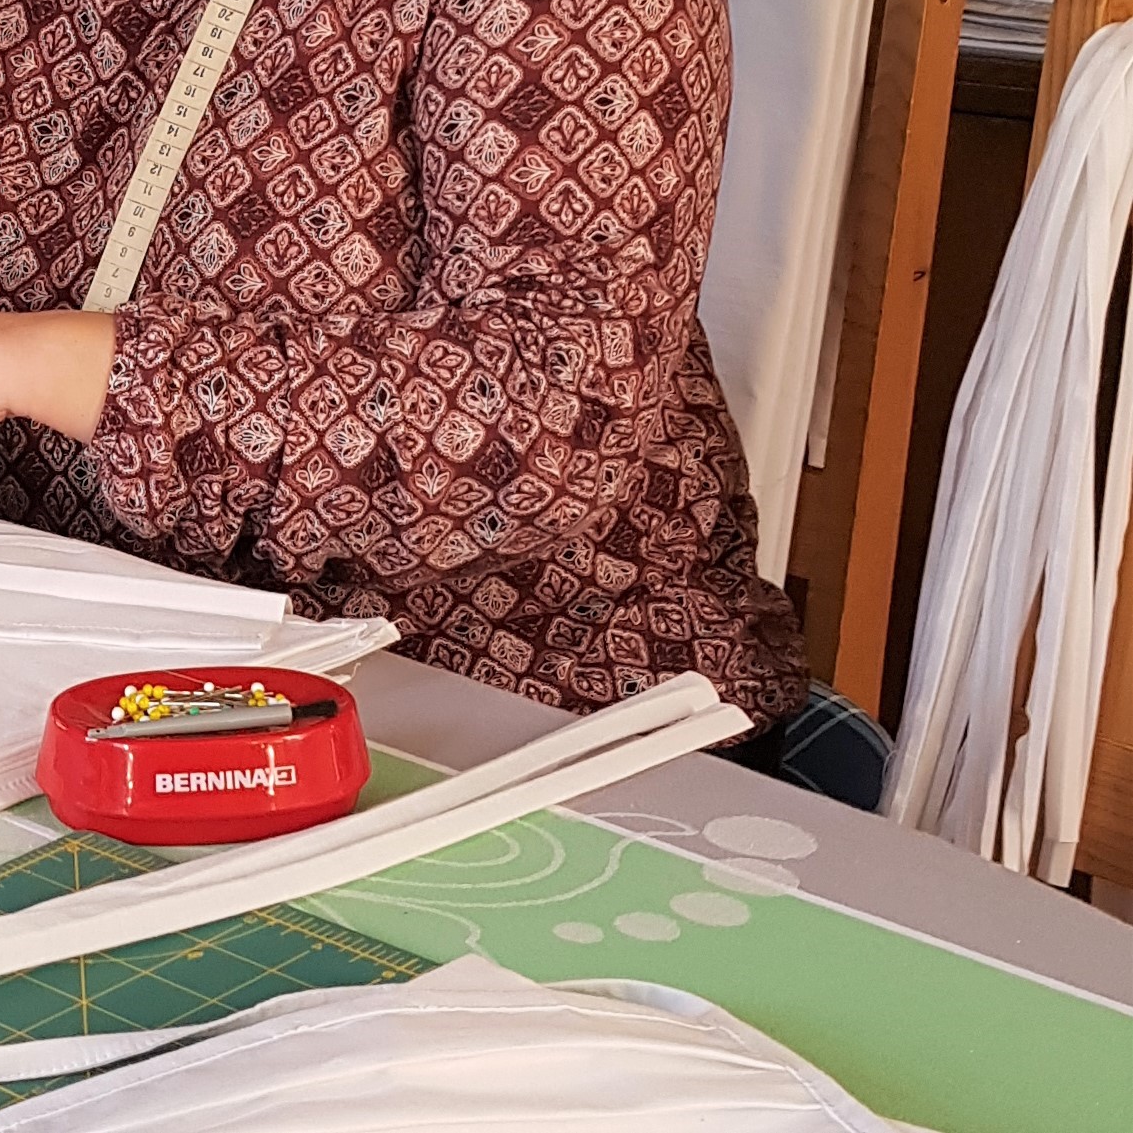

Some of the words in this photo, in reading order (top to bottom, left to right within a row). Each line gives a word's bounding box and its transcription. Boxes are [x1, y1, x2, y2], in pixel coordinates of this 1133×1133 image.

[217, 9, 232, 22] 20
[210, 27, 223, 40] 19
[201, 47, 214, 59] 18
[193, 65, 206, 78] 17
[183, 85, 197, 98] 16
[174, 105, 188, 118] 15
[167, 124, 180, 138] 14
[158, 145, 171, 157] 13
[150, 164, 162, 177] 12
[142, 183, 153, 195] 11
[132, 206, 145, 218] 10
[155, 768, 269, 793] BERNINA
